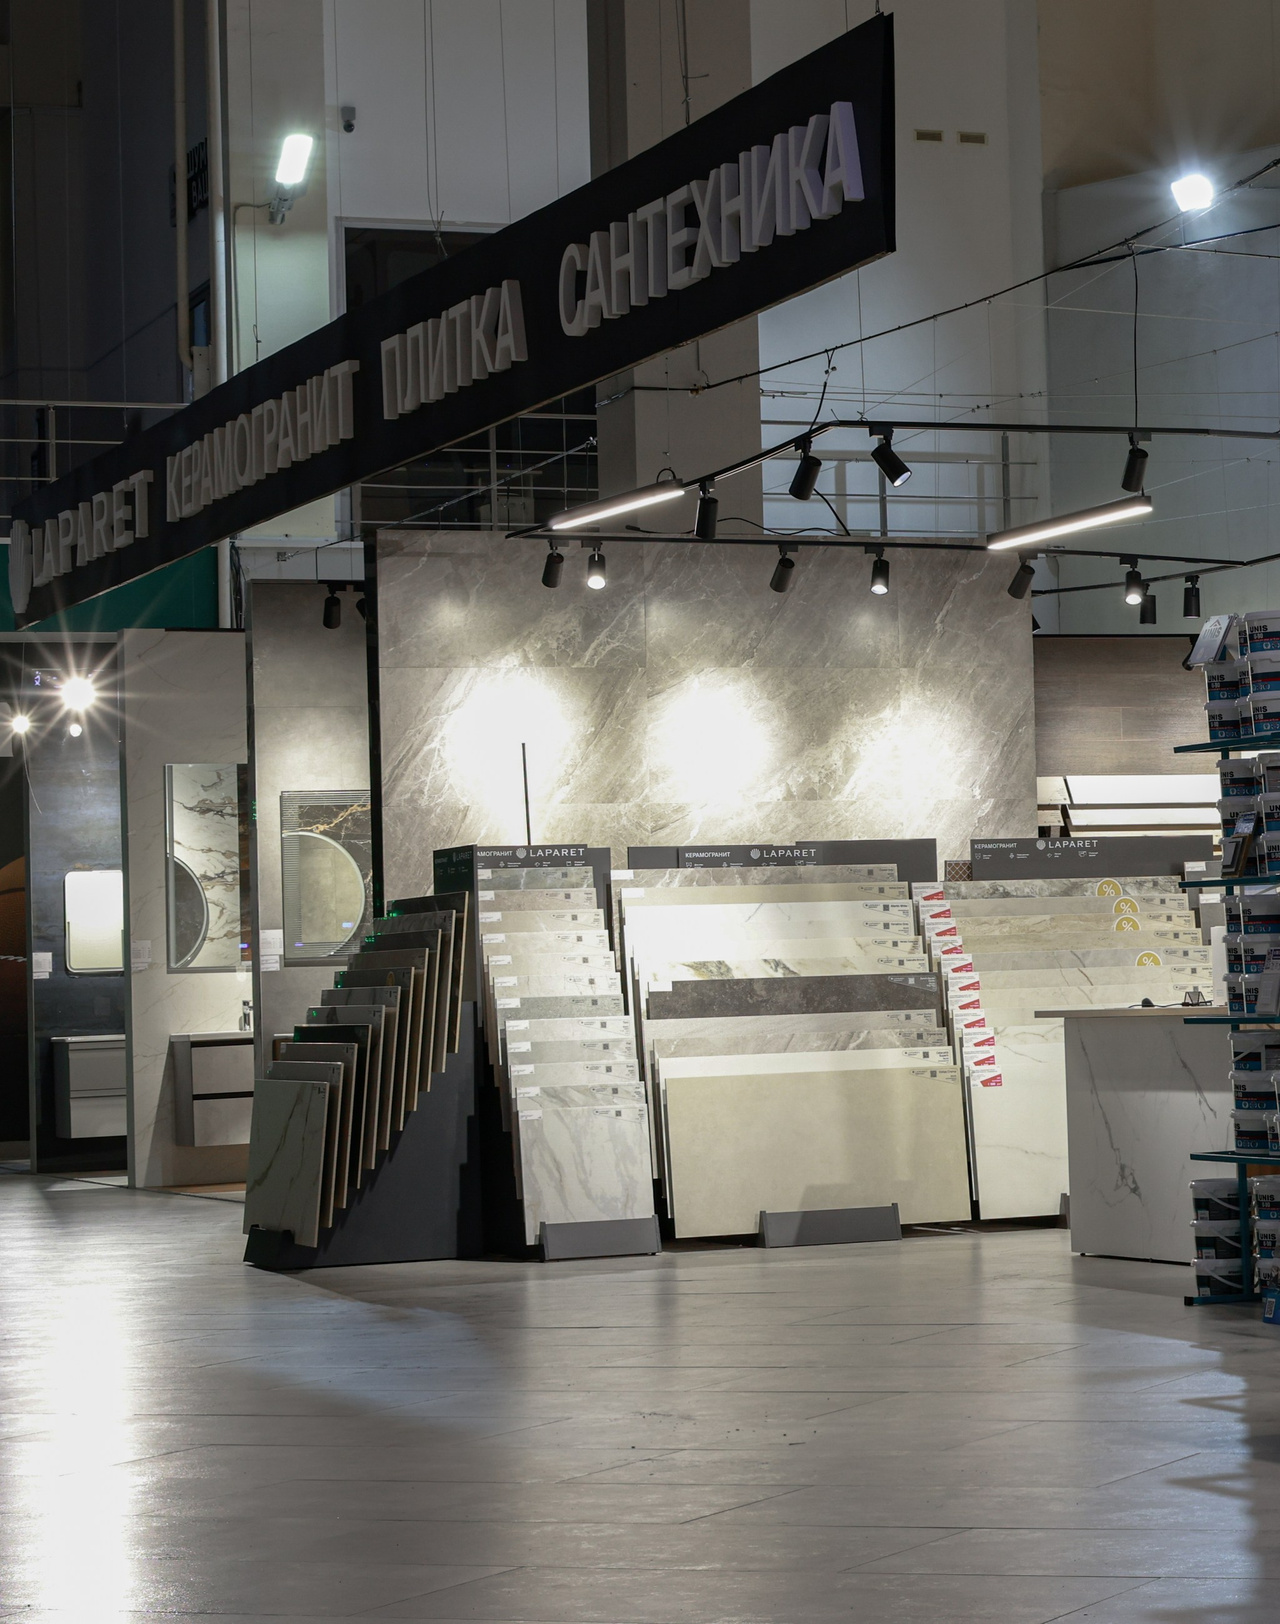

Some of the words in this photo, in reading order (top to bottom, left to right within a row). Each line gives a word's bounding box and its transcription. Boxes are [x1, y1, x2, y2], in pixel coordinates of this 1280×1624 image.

[166, 359, 360, 522] КЕРАМОГРАНИТ
[381, 279, 528, 421] ПЛИТКА
[559, 101, 865, 337] САНТЕХНИКА
[32, 470, 153, 587] LAPARET
[1249, 625, 1268, 633] UNIS
[1048, 840, 1098, 849] LAPARET
[530, 848, 585, 857] LAPARET
[763, 849, 817, 858] LAPARET
